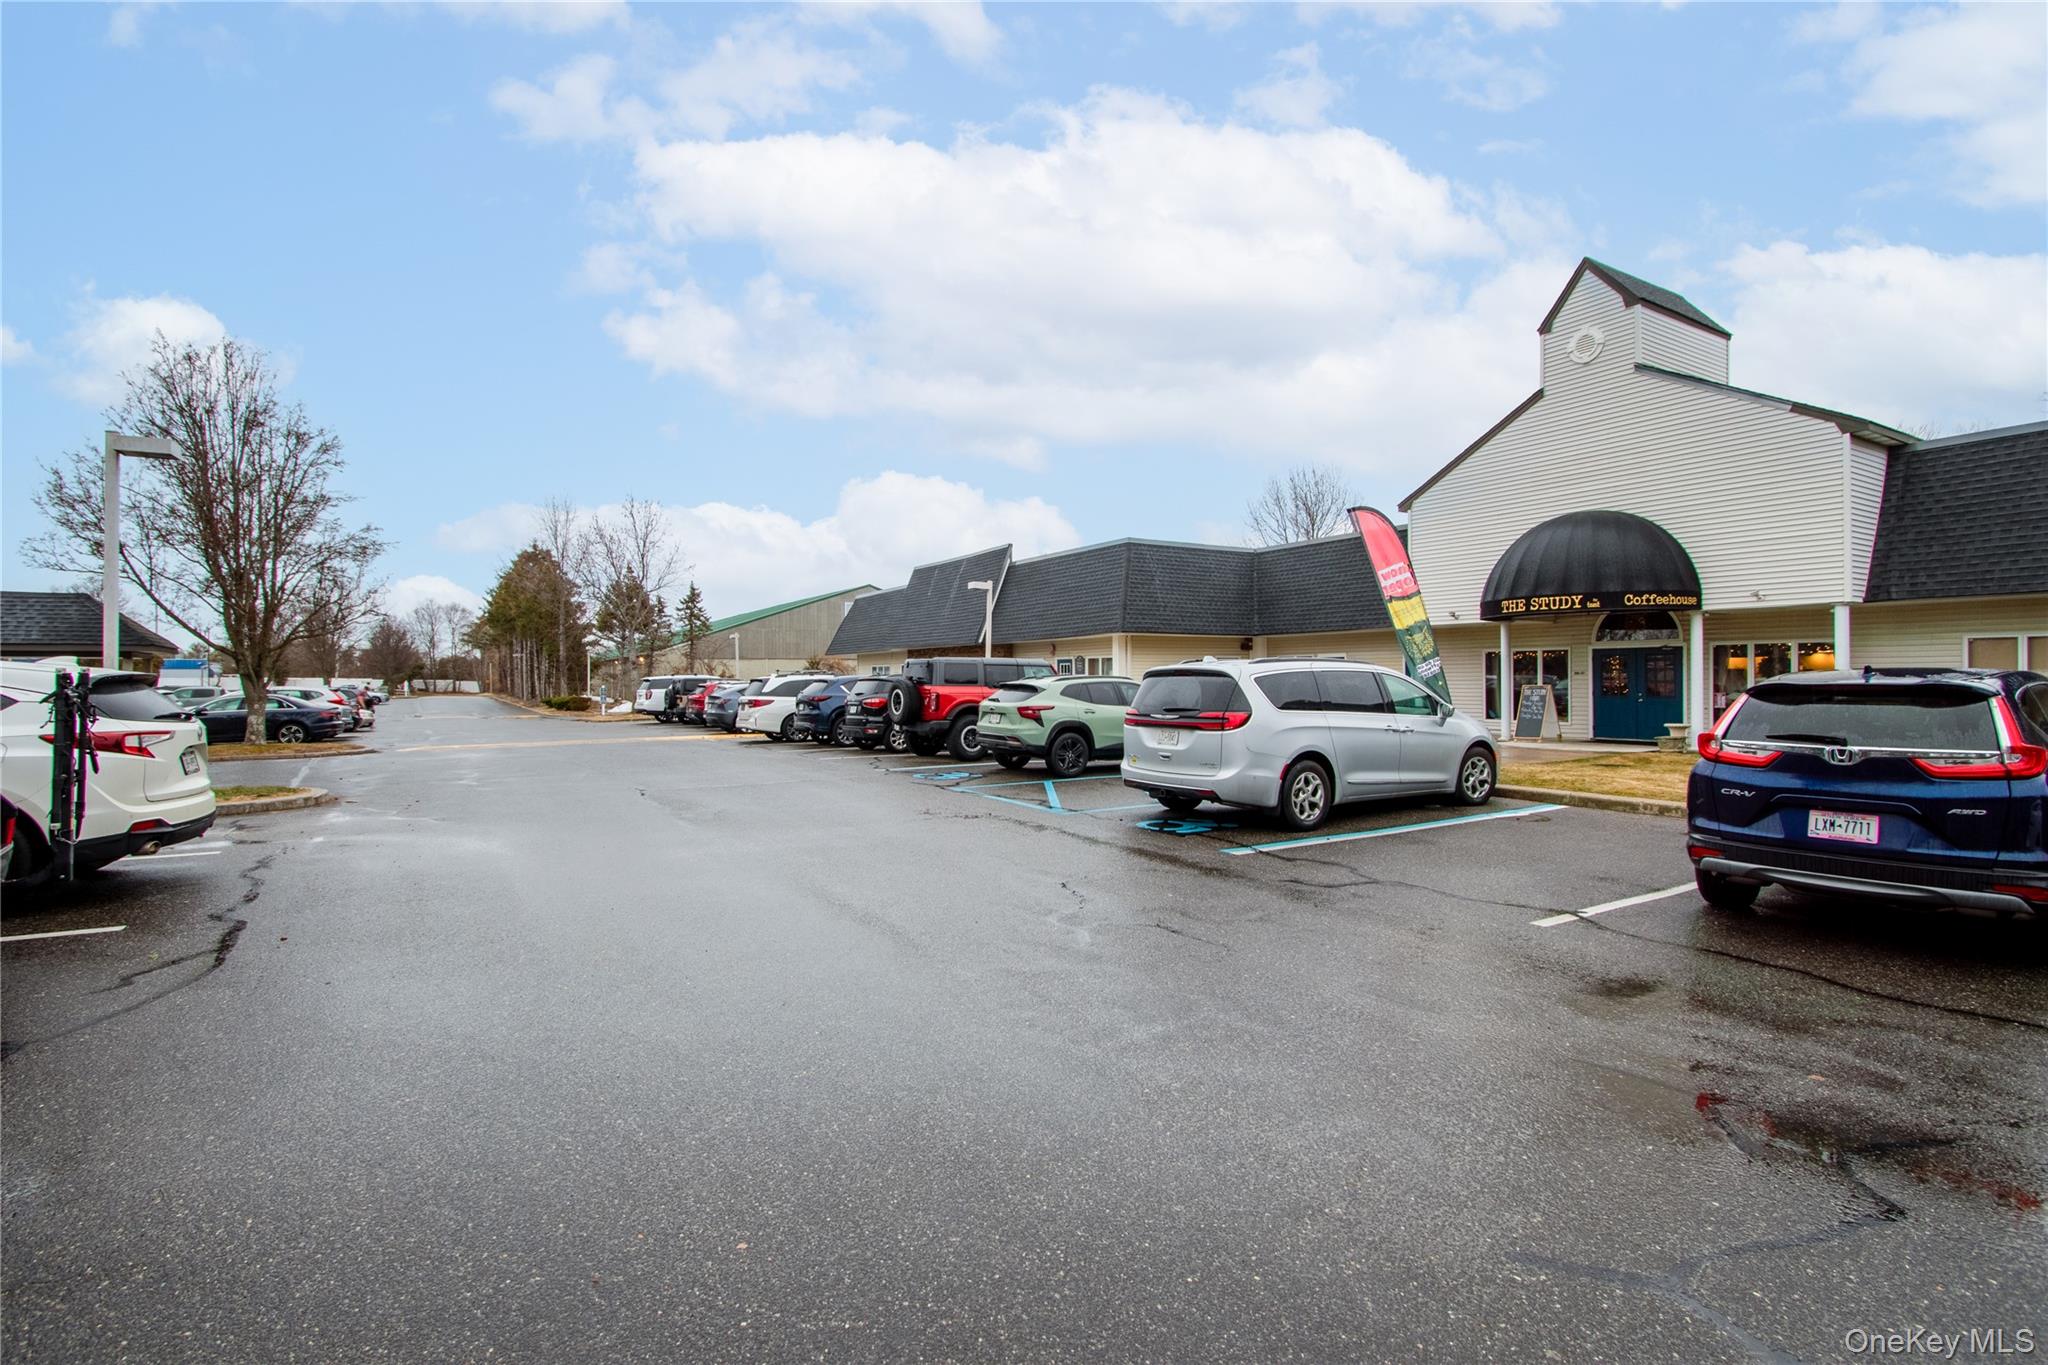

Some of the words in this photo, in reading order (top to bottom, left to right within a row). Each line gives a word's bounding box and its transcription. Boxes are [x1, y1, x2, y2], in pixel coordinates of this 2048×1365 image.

[1501, 599, 1526, 613] THE
[1530, 595, 1584, 611] STUDY
[1624, 593, 1698, 606] Coffeehouse
[1720, 787, 1756, 797] CR-V
